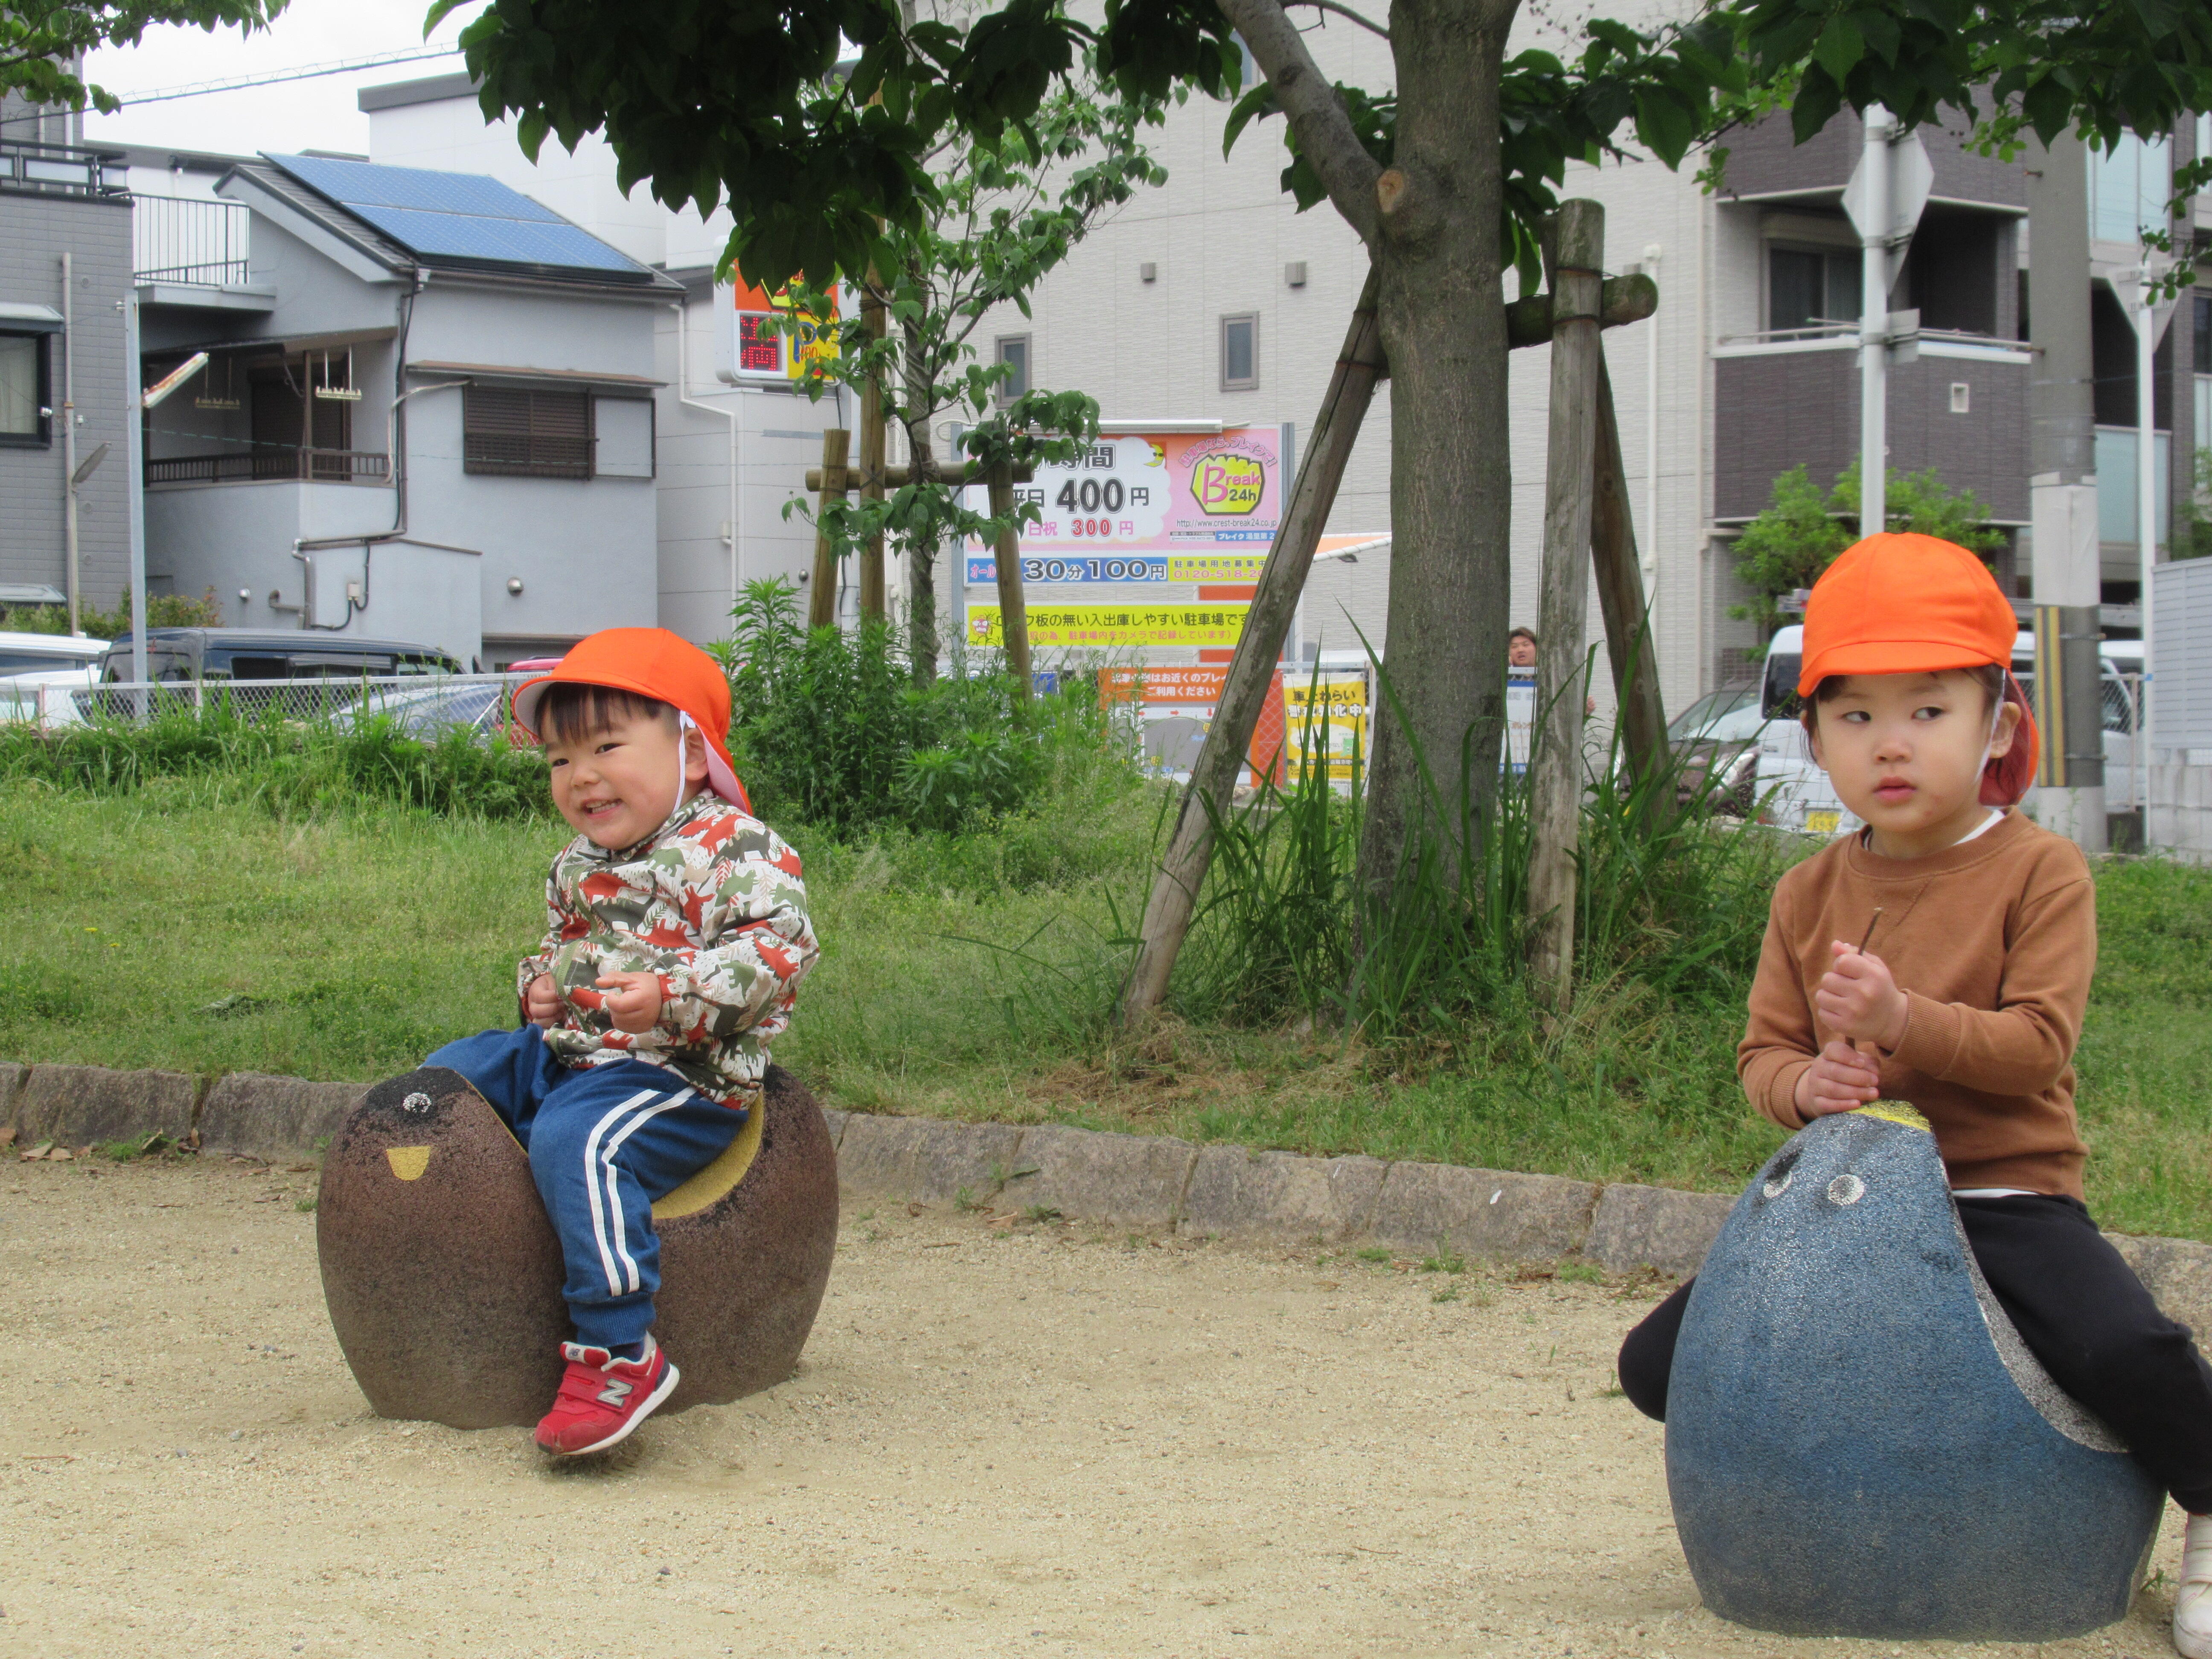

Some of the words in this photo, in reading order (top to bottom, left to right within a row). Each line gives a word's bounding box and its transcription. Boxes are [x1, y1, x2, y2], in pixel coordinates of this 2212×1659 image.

[1202, 463, 1261, 505] Break
[1056, 477, 1126, 514] 400
[1131, 487, 1150, 506] 円
[1228, 489, 1257, 501] 24h
[1071, 518, 1112, 537] 300
[1119, 521, 1134, 536] 円
[1176, 518, 1277, 528] http://www.crest-break24.co.jp
[996, 613, 1249, 627] ク板の無い入出庫しやすい駐車場です
[598, 1378, 633, 1408] N
